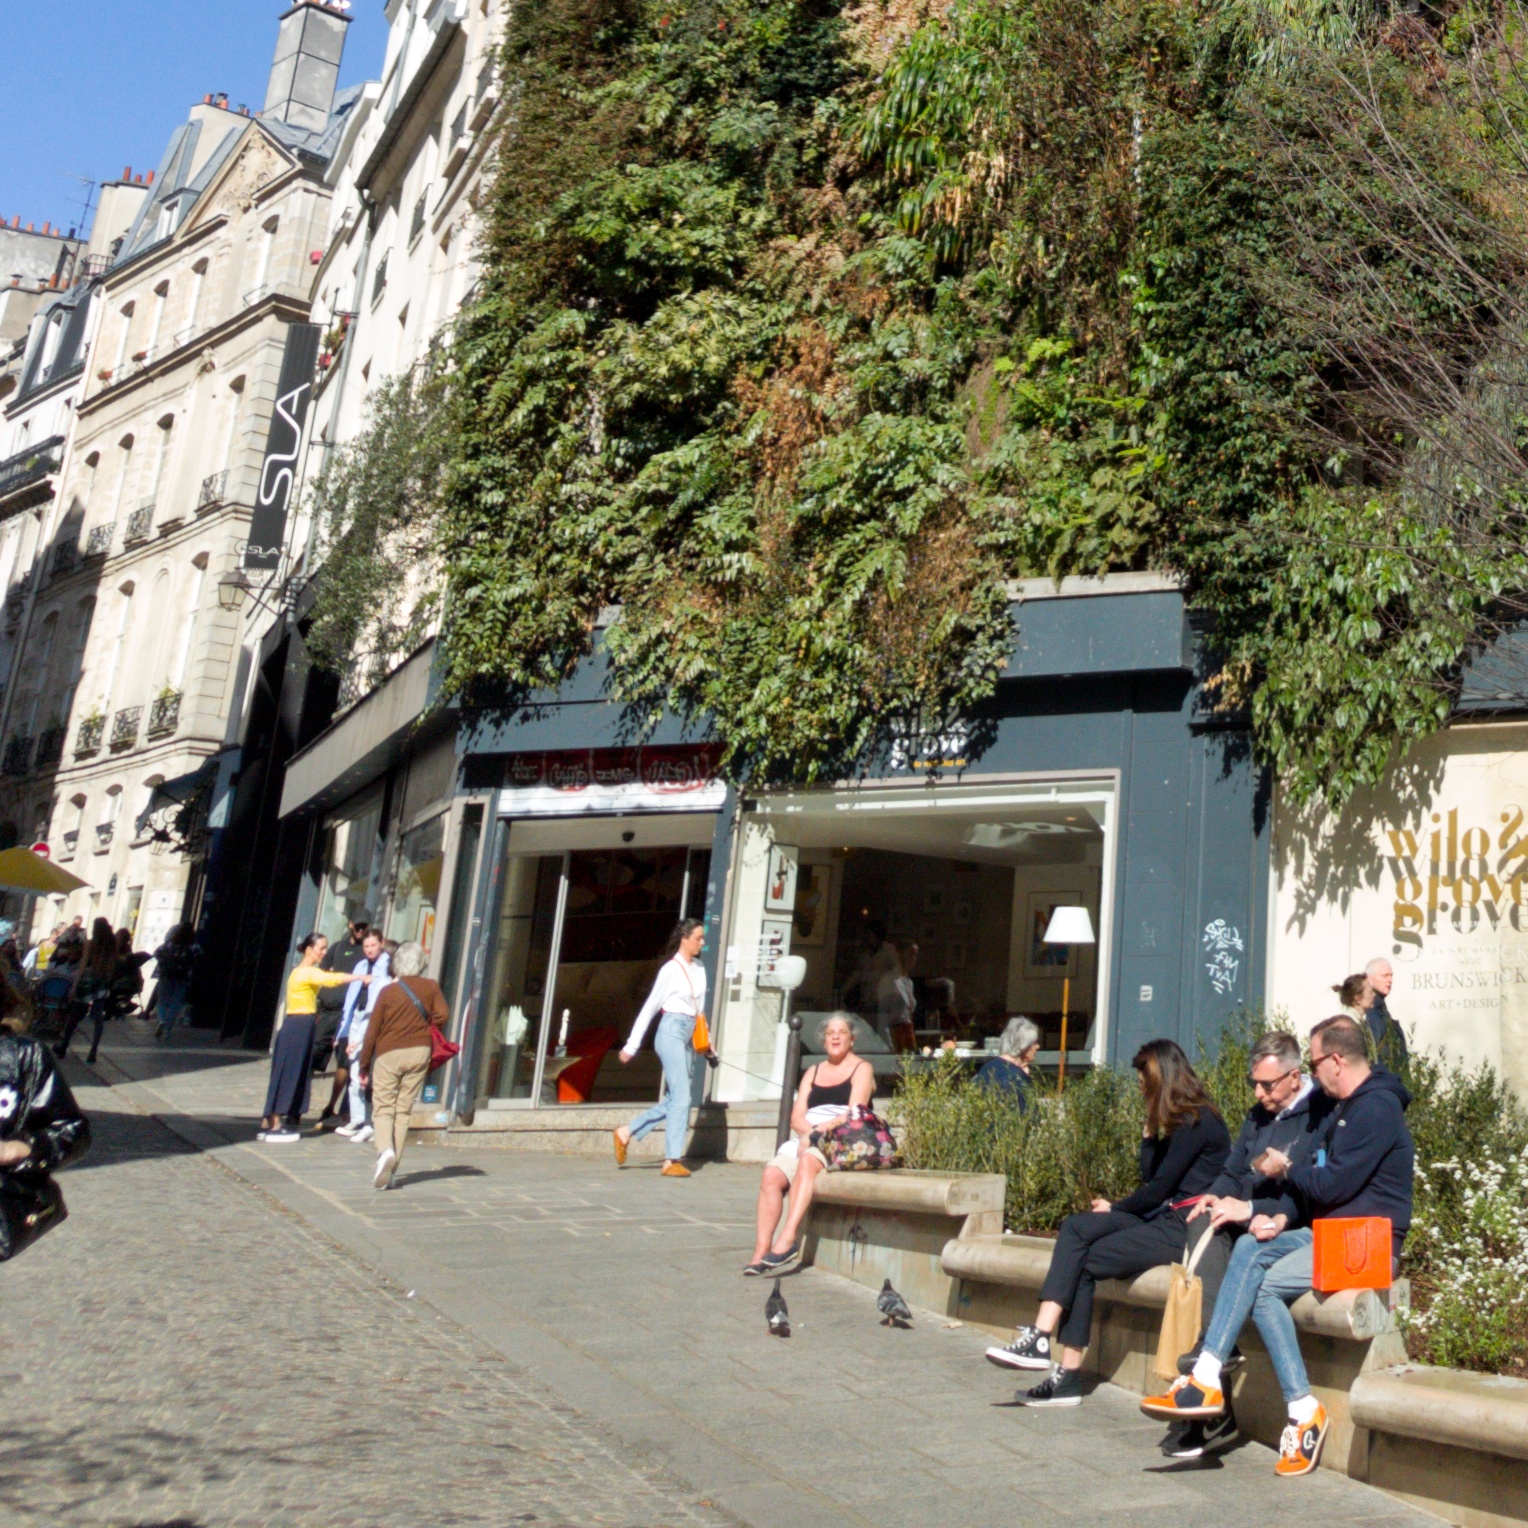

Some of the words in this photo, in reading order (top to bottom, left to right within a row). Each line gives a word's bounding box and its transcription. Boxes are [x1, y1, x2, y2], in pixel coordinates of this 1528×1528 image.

[259, 382, 311, 512] SLA
[1386, 806, 1491, 862] wilo
[1412, 967, 1528, 990] BRUNSWICK
[1429, 1000, 1455, 1010] ART
[1463, 992, 1509, 1009] DESIGN
